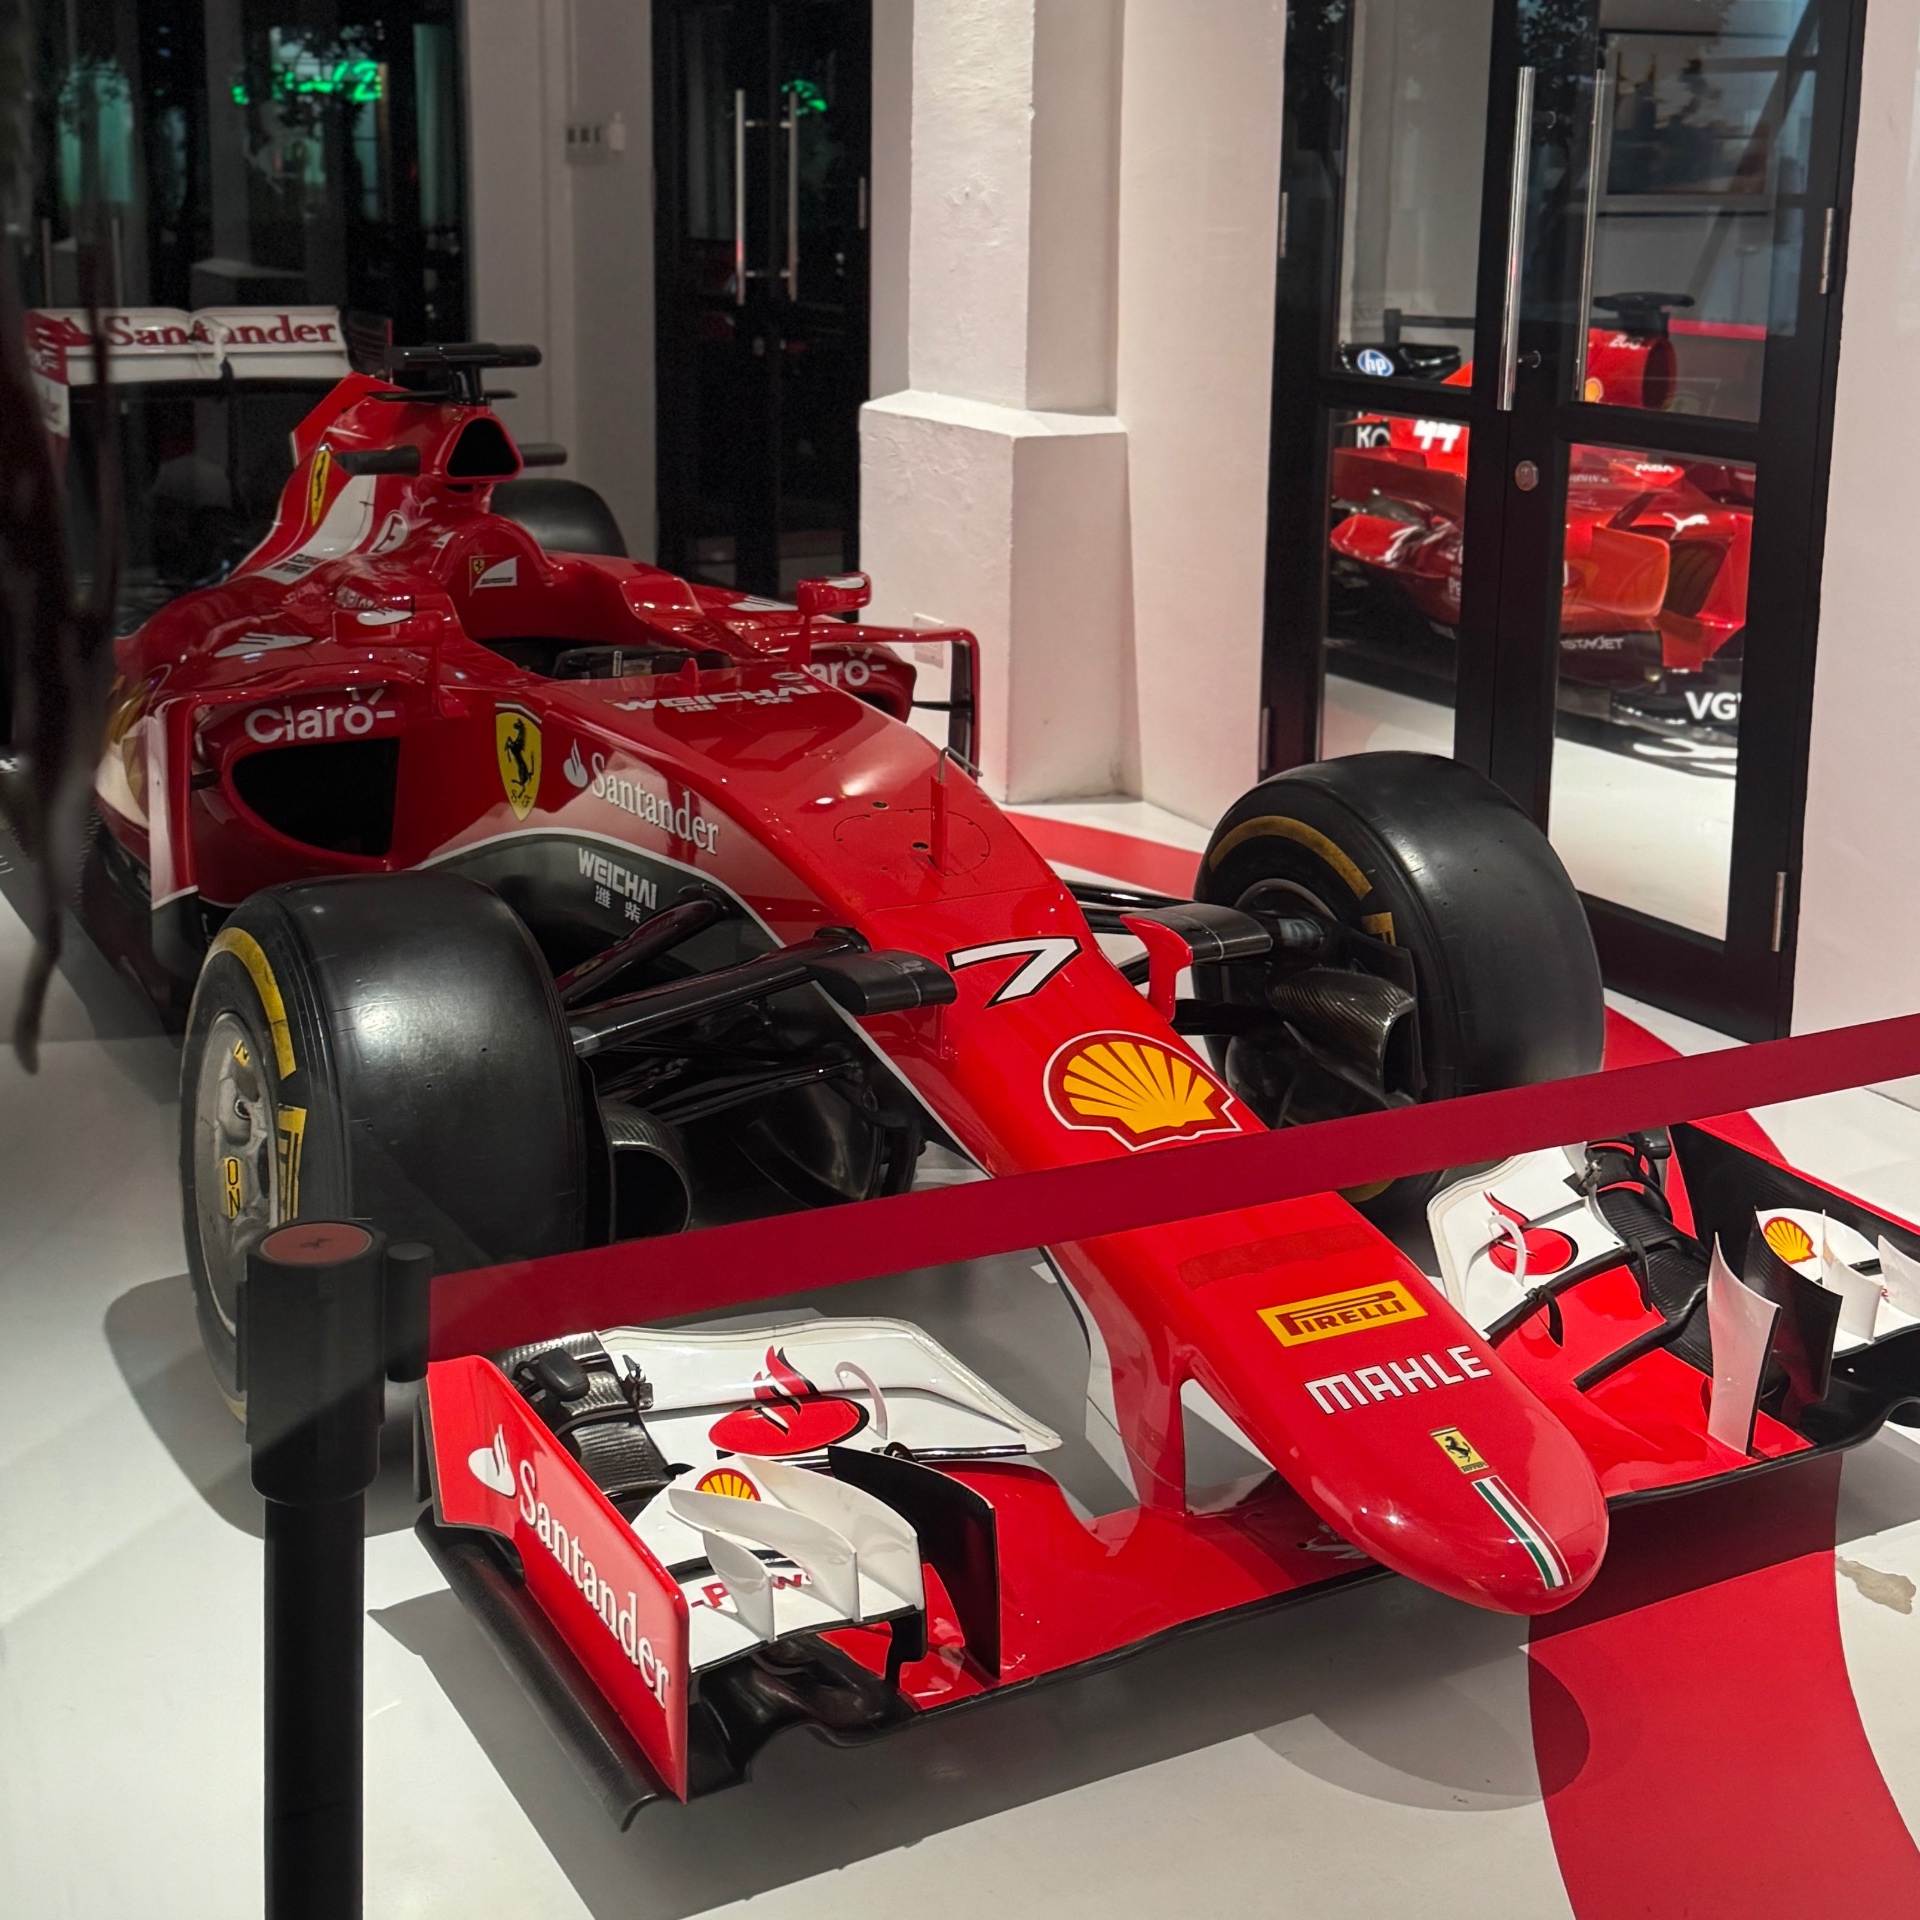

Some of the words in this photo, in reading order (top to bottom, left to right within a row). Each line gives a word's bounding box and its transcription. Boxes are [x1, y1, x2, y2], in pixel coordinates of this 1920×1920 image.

[1363, 348, 1389, 377] hp
[612, 684, 821, 711] WEICHAI
[810, 660, 870, 687] aro
[1686, 691, 1742, 720] VG
[591, 752, 720, 855] Santander
[578, 847, 656, 910] WEICHAI
[946, 936, 1083, 1009] 7
[1275, 1290, 1407, 1336] PIRELLI
[1304, 1345, 1491, 1415] MAHLE
[517, 1458, 673, 1711] Santander
